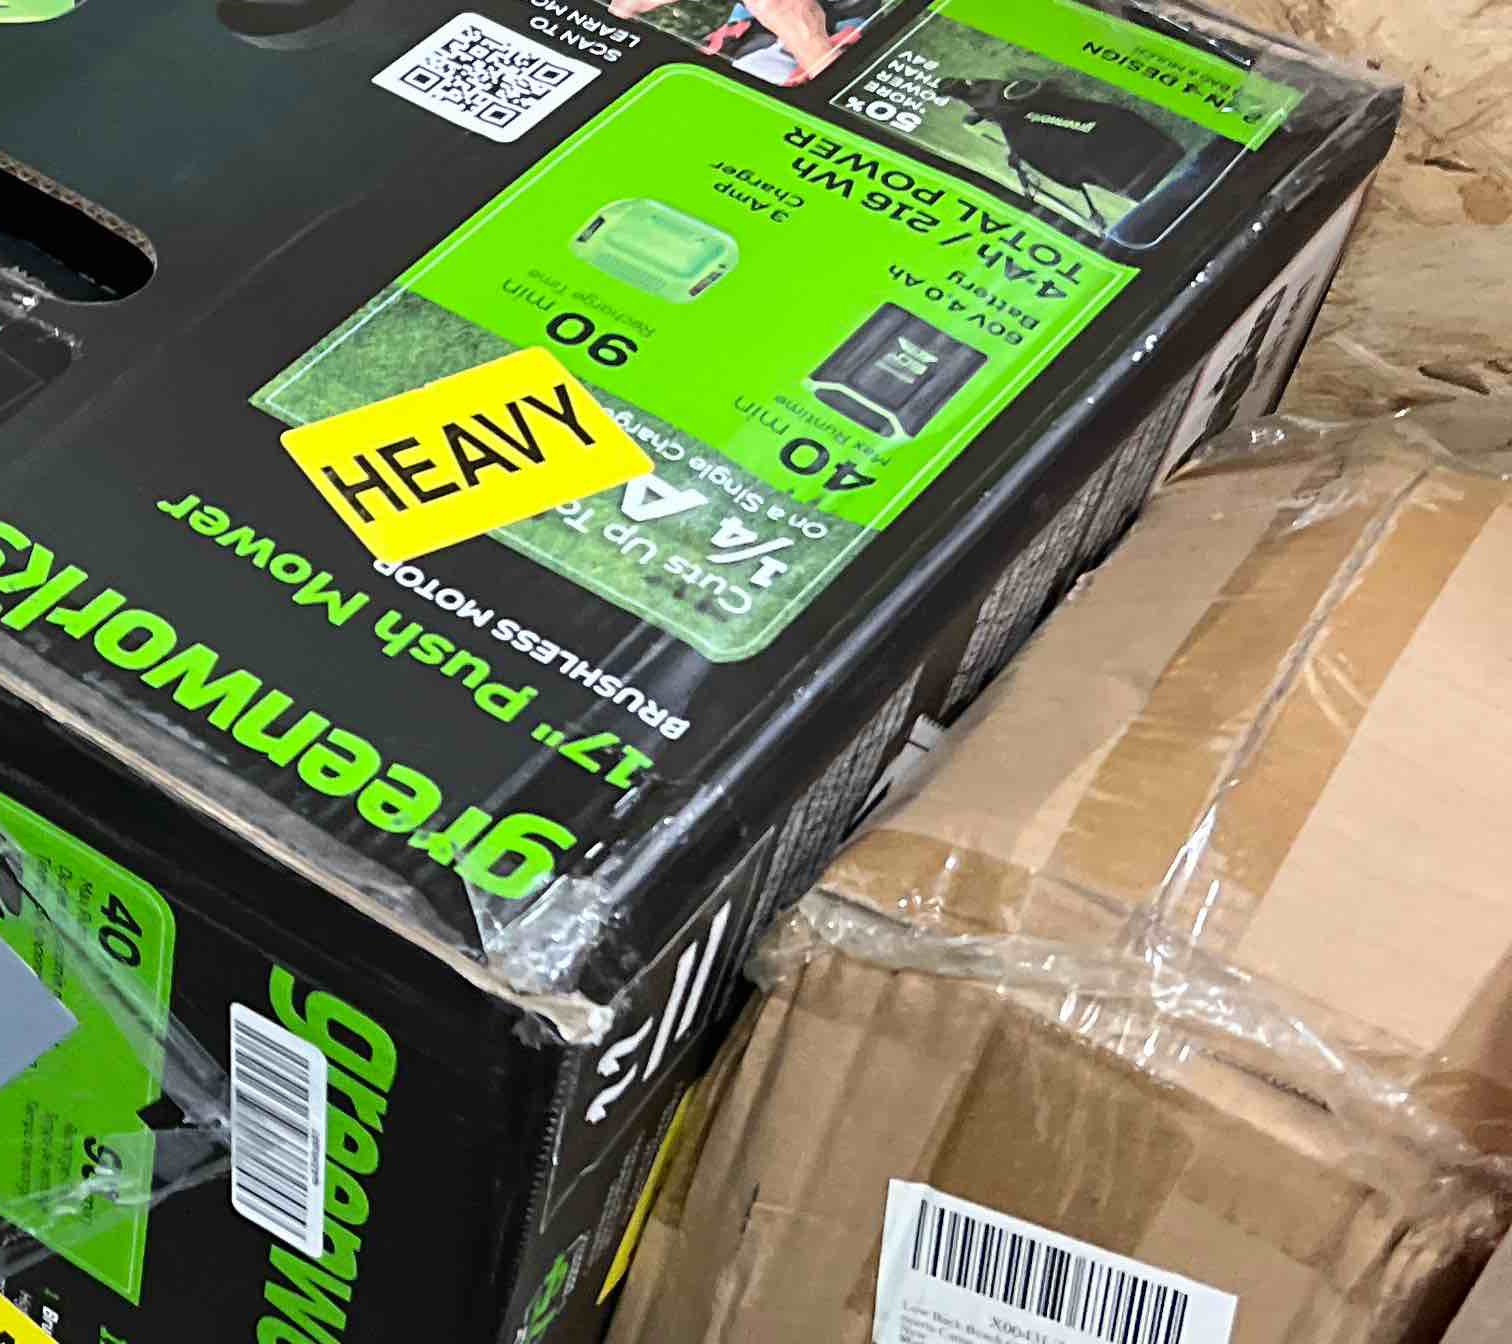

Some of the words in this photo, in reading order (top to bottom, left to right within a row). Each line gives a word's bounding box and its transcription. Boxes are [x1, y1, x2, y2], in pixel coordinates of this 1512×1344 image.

[526, 14, 559, 34] TO
[557, 28, 622, 61] SCAN
[566, 9, 642, 47] LEARN
[885, 59, 945, 88] THAN
[1079, 40, 1179, 87] DESIGN
[874, 69, 950, 106] POWER
[708, 159, 807, 208] Charger
[784, 127, 943, 204] POWER
[787, 155, 857, 197] Wh
[710, 180, 771, 211] Amp
[768, 209, 789, 221] 3
[859, 190, 940, 233] 216
[959, 199, 1080, 282] TOTAL
[497, 278, 557, 313] min
[524, 268, 569, 295] Time
[883, 263, 925, 290] Ah
[921, 284, 968, 313] 4.0
[568, 289, 657, 337] Recharge
[947, 270, 1039, 329] Battery
[546, 313, 636, 366] 90
[965, 311, 1025, 345] 60V
[726, 394, 792, 439] min
[768, 394, 852, 446] Runtime
[321, 384, 596, 523] HEAVY
[780, 437, 873, 491] 40
[850, 440, 892, 467] Max
[689, 457, 763, 512] Single
[763, 503, 786, 520] a
[784, 511, 830, 540] On
[159, 496, 366, 623] Mower
[598, 519, 662, 564] Up
[664, 555, 751, 613] Cuts
[375, 611, 535, 720] Push
[492, 619, 688, 738] BRUSHLESS
[533, 724, 651, 787] 17"
[97, 890, 143, 970] 40
